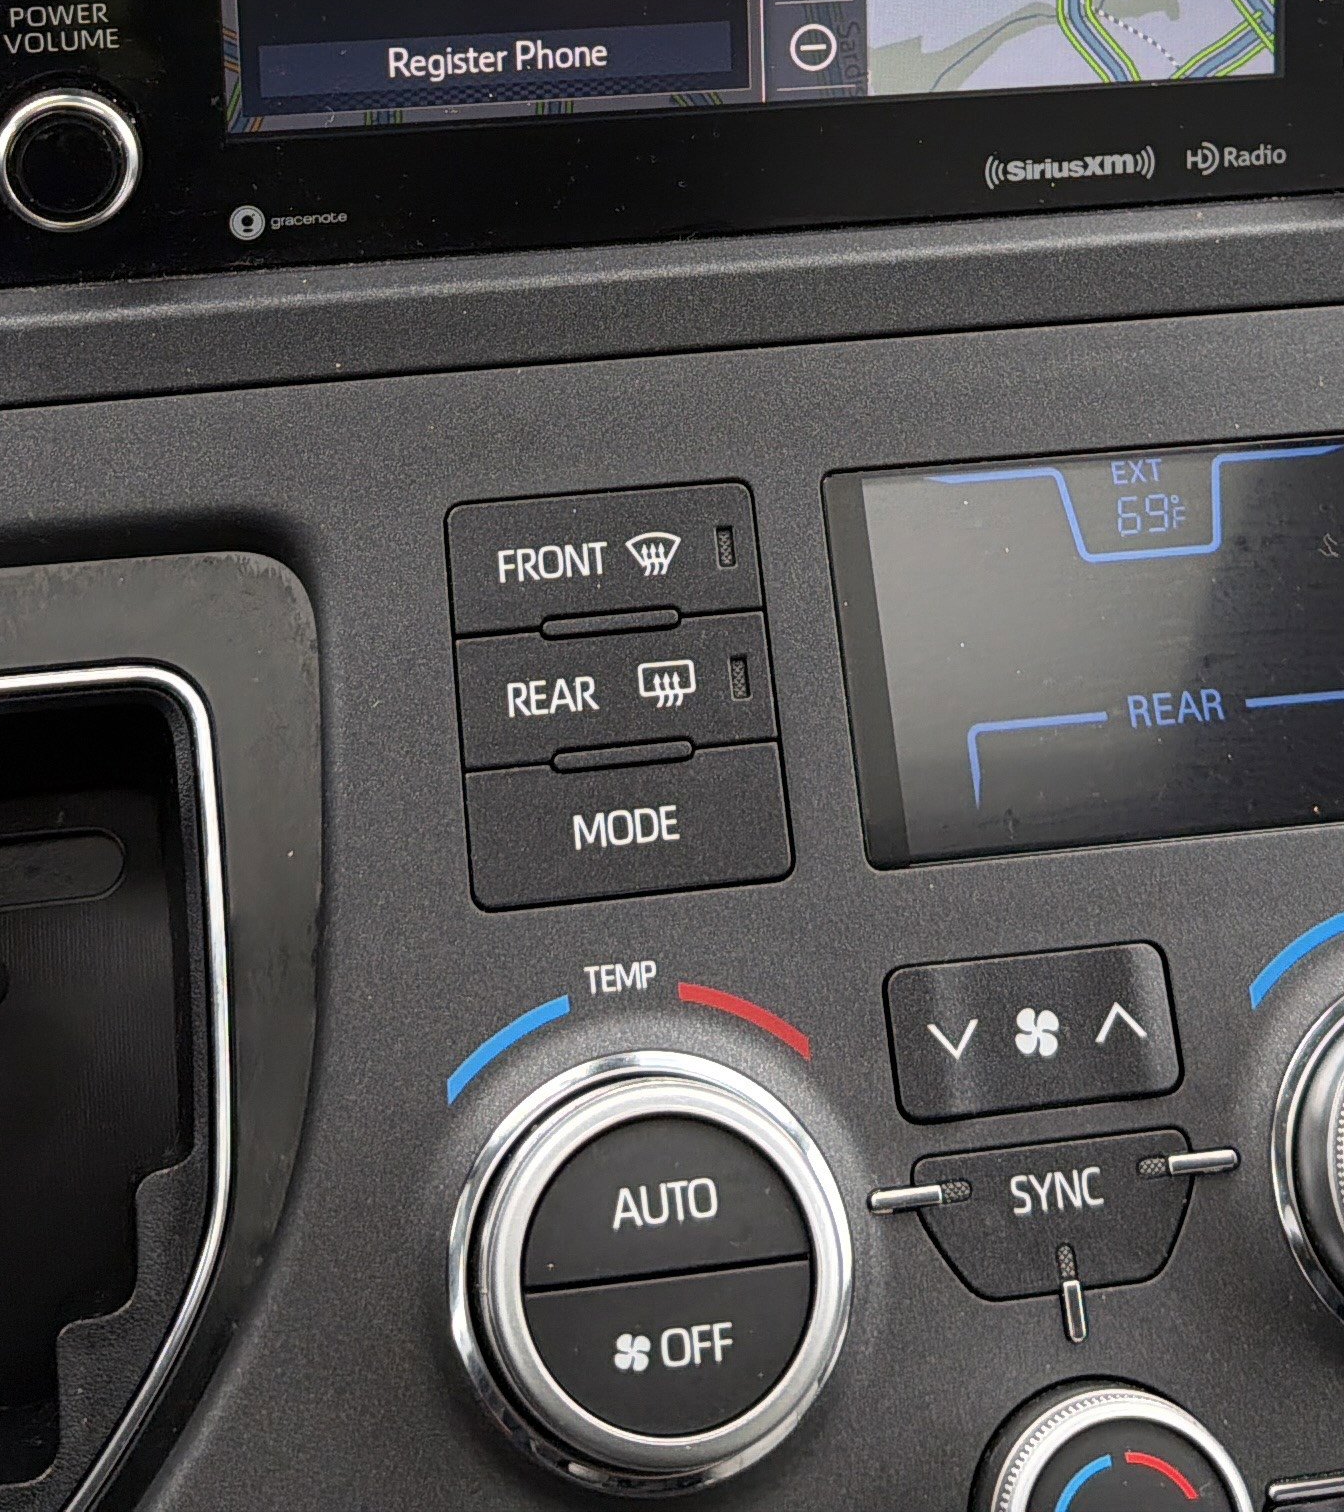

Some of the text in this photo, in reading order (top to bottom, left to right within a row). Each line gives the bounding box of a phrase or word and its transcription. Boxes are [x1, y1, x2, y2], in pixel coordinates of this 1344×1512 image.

[9, 2, 109, 28] POWER
[3, 28, 120, 53] VOLUME
[387, 40, 609, 82] Register Phone
[1186, 141, 1288, 176] HD Radio
[270, 212, 348, 230] gracenote
[1111, 458, 1162, 485] EXT
[497, 541, 608, 584] FRONT
[507, 675, 600, 718] REAR
[1128, 689, 1226, 728] REAR
[572, 805, 682, 851] MODE
[584, 960, 658, 994] TEMP
[611, 1176, 719, 1229] AUTO
[1010, 1166, 1105, 1215] SYNC
[660, 1322, 734, 1369] OFF
